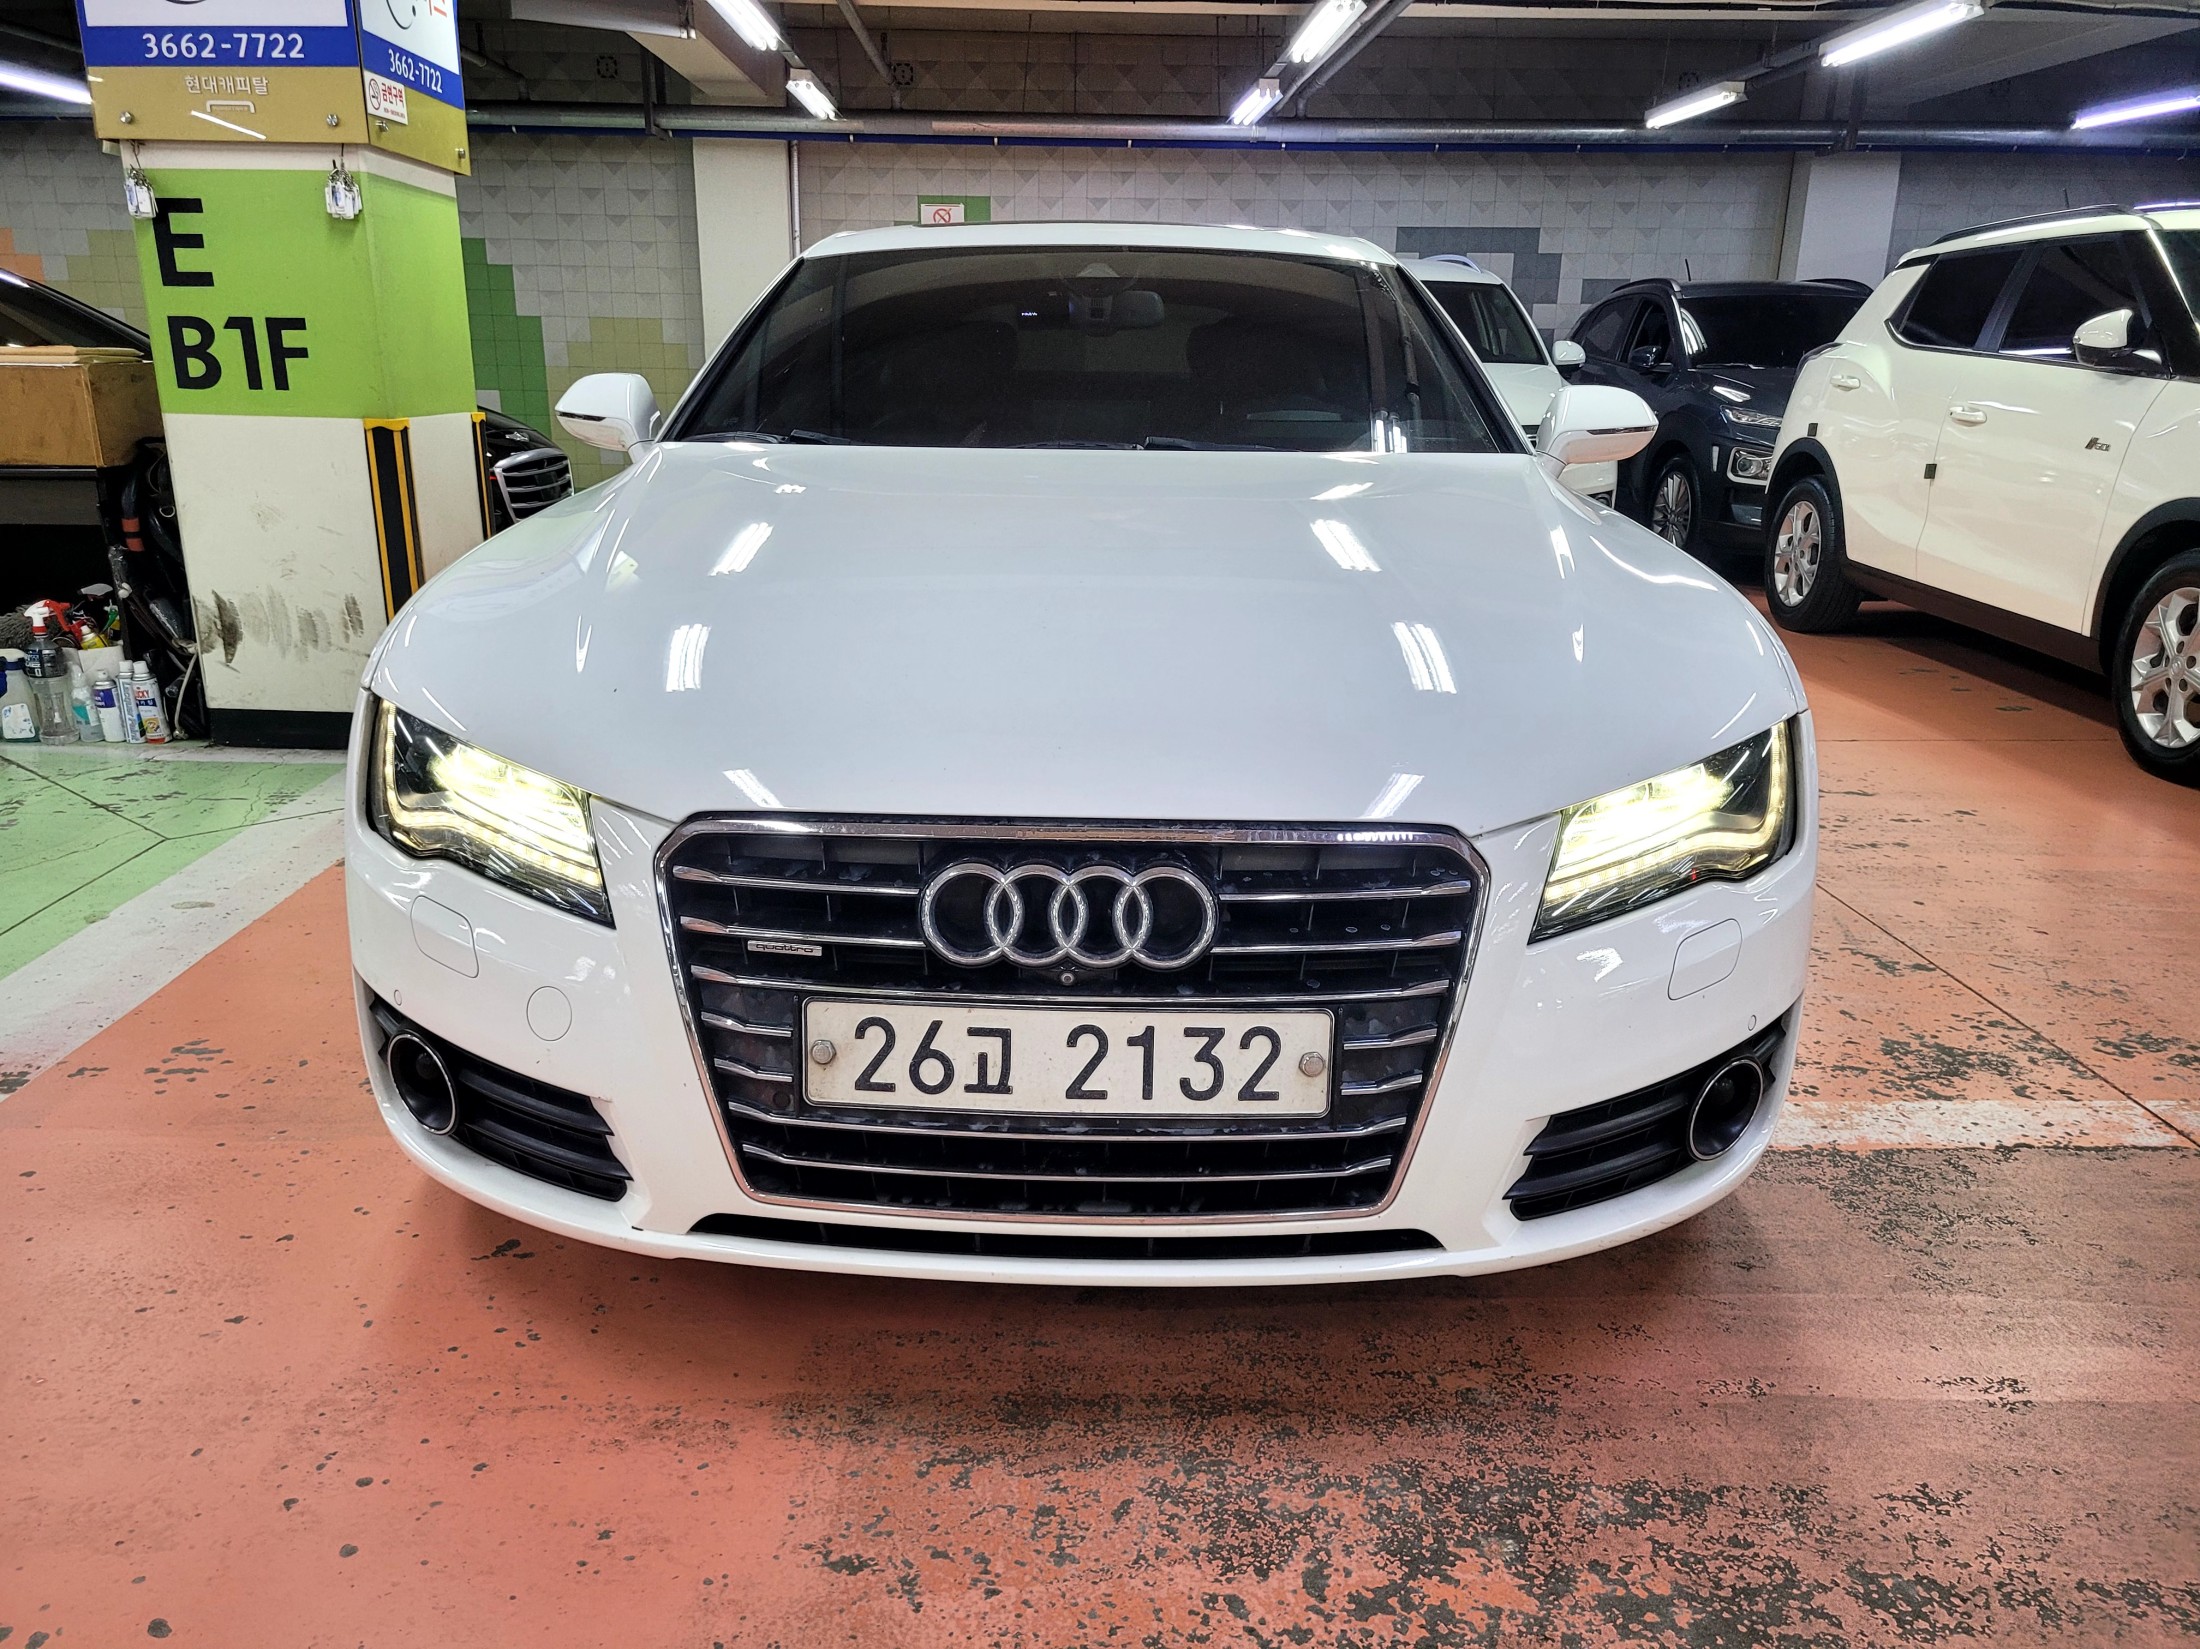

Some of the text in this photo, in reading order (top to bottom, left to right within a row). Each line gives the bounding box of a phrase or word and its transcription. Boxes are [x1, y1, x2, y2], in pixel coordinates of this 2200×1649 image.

[142, 33, 305, 59] 3662-7722
[184, 75, 269, 95] 현대캐피탈
[388, 48, 443, 94] 3662-7722
[381, 82, 404, 109] 금연구역
[153, 197, 215, 287] E
[167, 315, 310, 391] B1F
[755, 943, 814, 953] quattro
[854, 1016, 1282, 1101] 26고 2132
